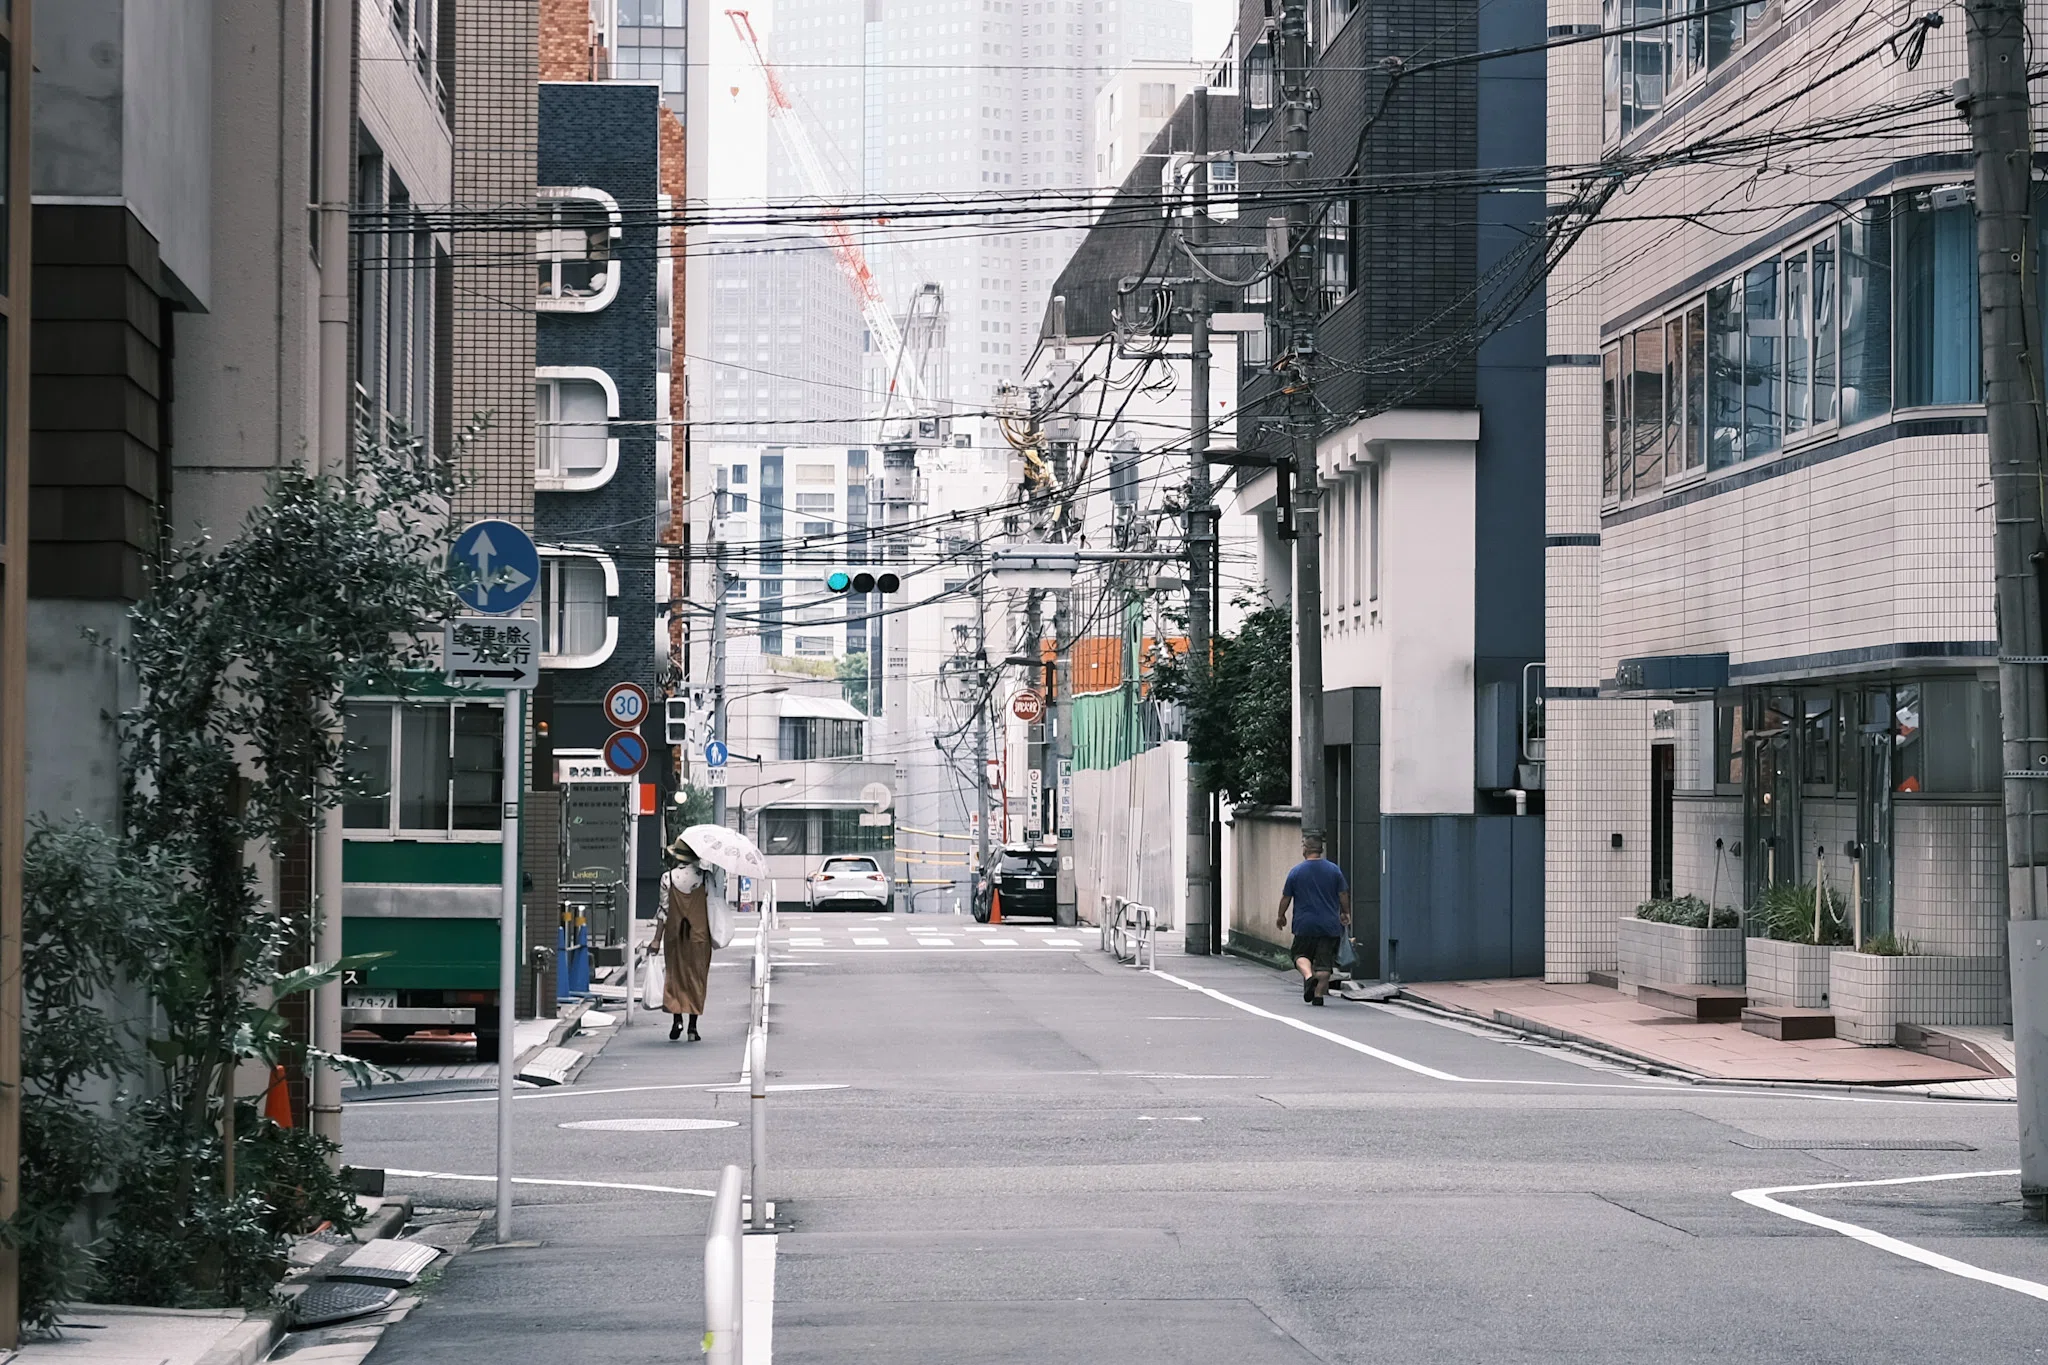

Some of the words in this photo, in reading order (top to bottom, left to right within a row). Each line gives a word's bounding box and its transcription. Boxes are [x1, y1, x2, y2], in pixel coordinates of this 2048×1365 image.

[452, 647, 531, 664] 一方行
[615, 696, 639, 715] 30
[1014, 701, 1038, 713] 消火栓
[343, 970, 359, 984] ス
[358, 998, 394, 1008] 79-24
